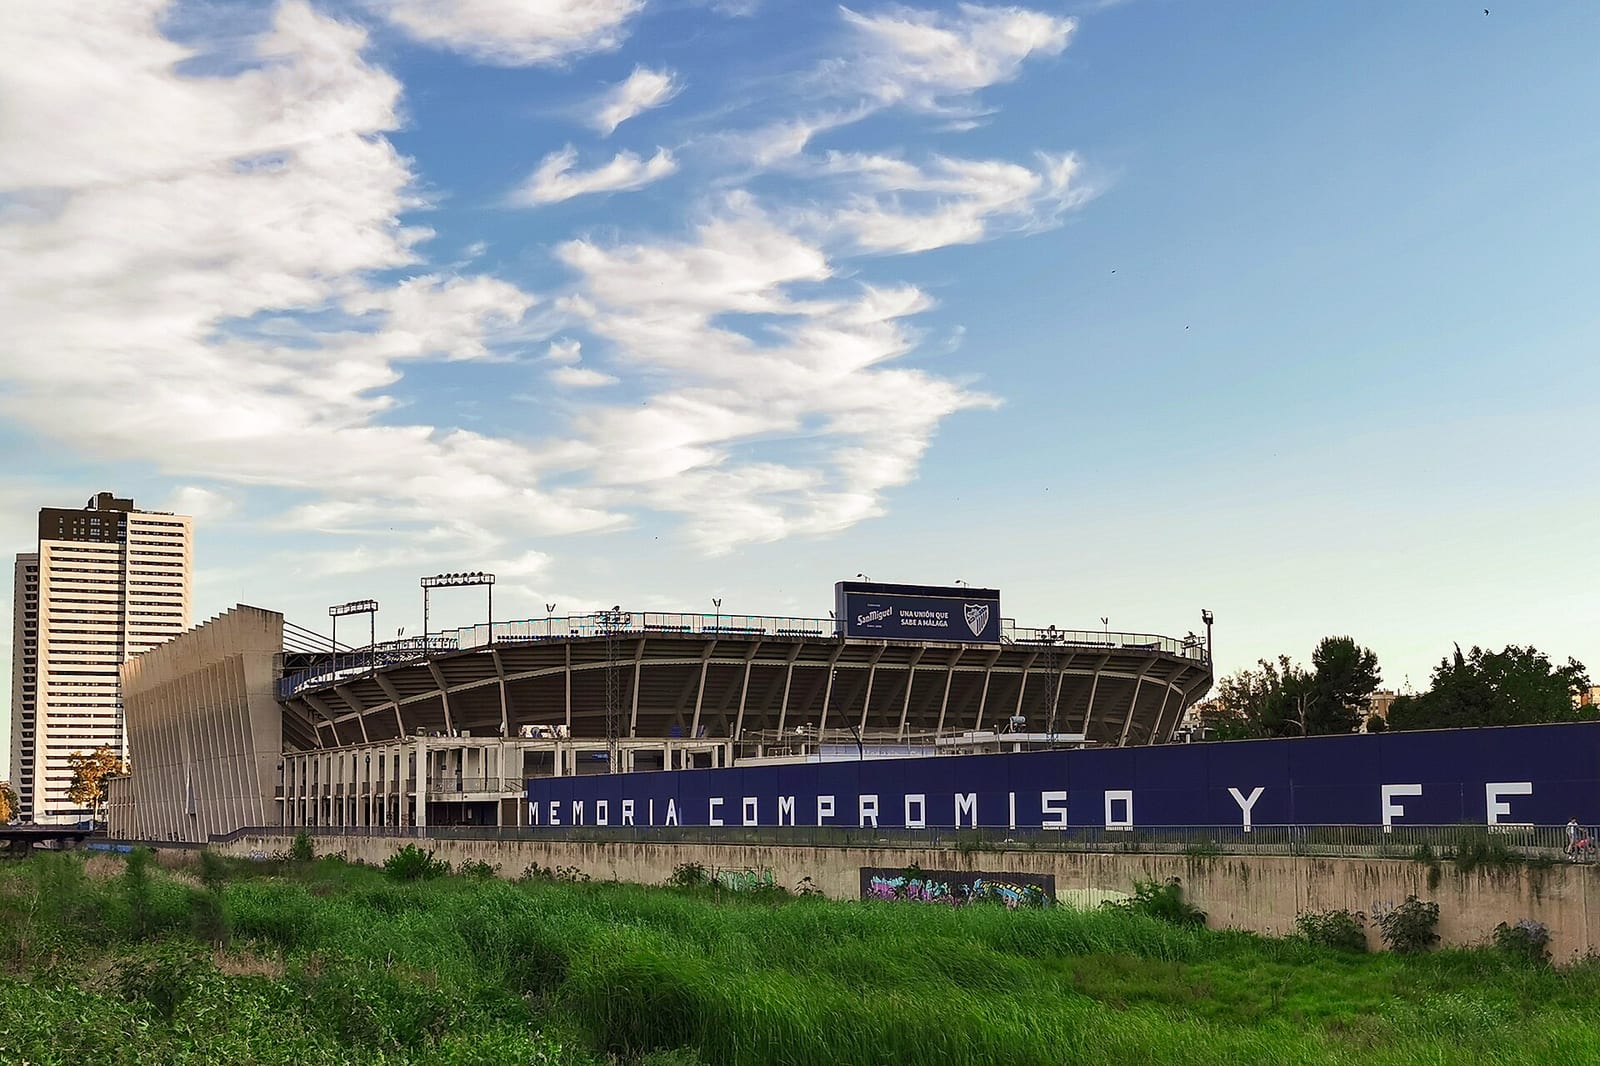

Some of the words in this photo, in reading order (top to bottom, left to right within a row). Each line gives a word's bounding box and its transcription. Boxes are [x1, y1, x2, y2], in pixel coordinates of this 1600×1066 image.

[914, 610, 934, 618] UNIÓN
[935, 612, 949, 620] QUE
[901, 618, 917, 626] SABE
[528, 798, 678, 826] MEMORIA
[708, 790, 1134, 832] COMPROMISO
[1228, 787, 1265, 832] Y
[1381, 782, 1535, 834] FE
